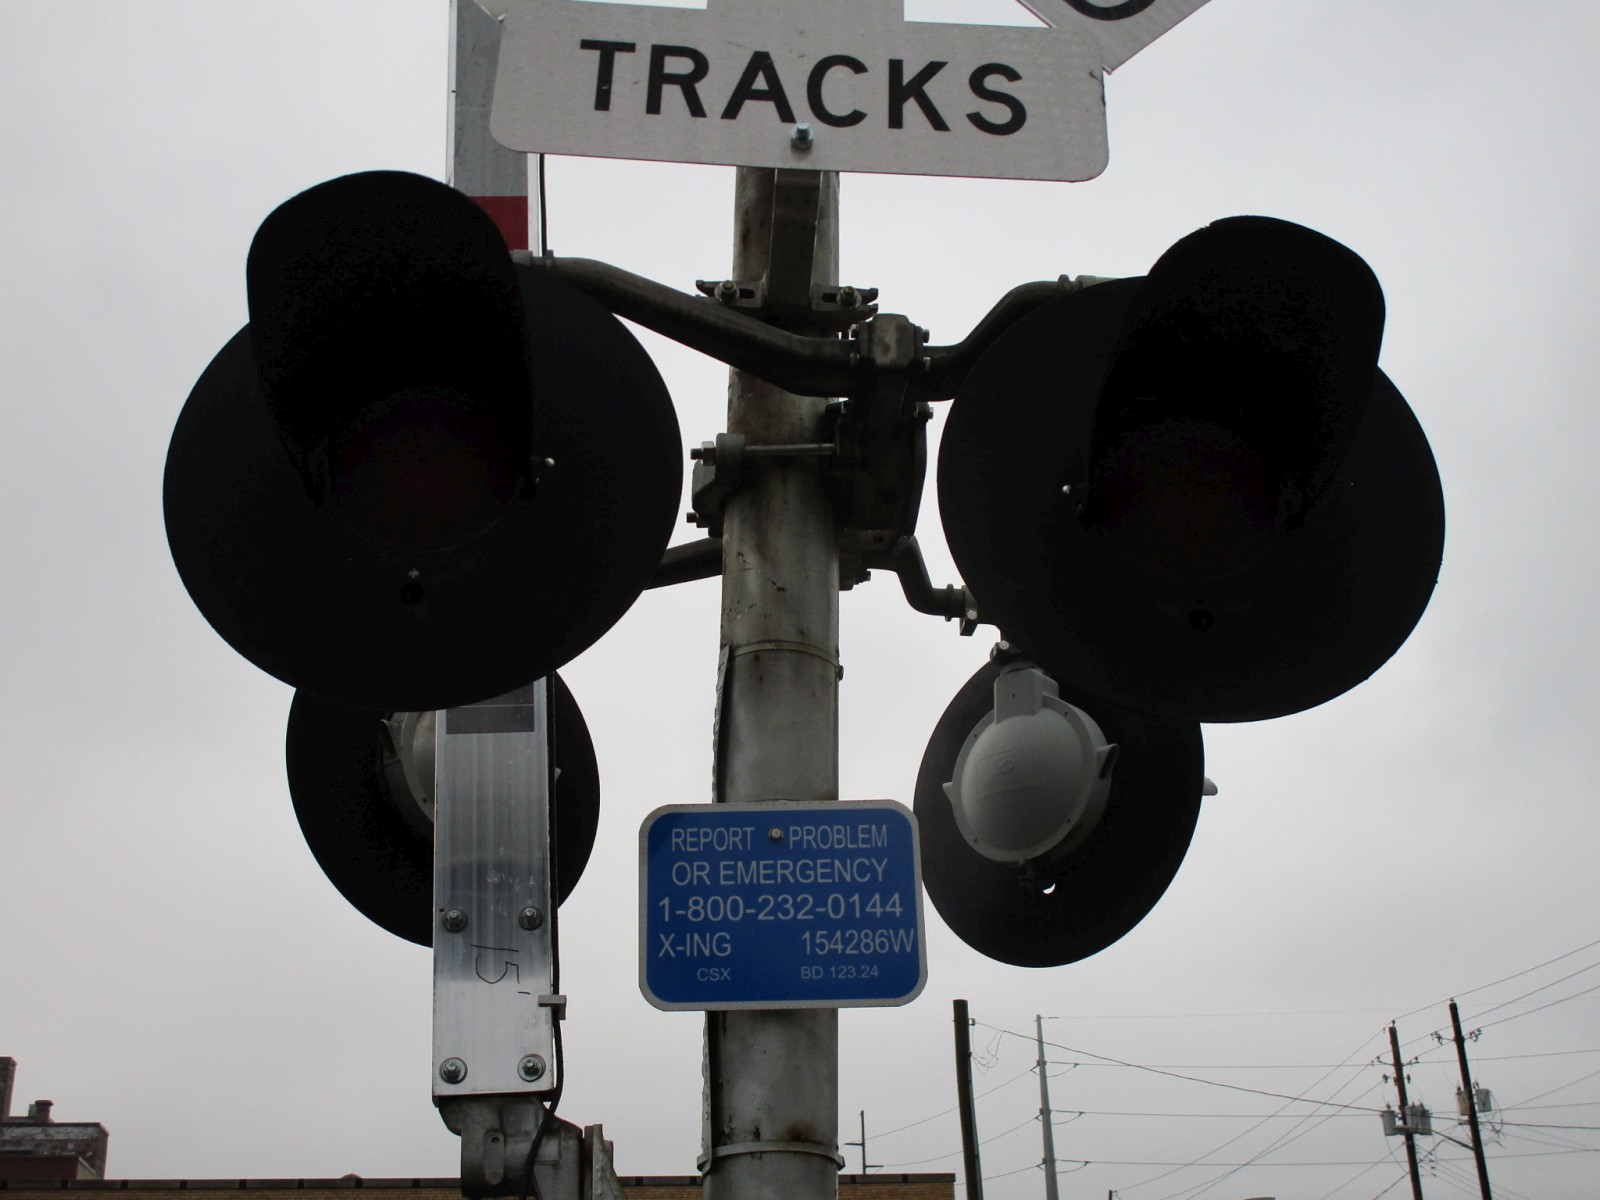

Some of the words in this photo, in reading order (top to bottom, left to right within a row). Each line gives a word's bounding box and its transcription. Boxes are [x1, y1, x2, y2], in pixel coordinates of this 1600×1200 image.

[579, 39, 1028, 135] TRACKS
[671, 827, 755, 852] REPORT
[789, 824, 888, 849] PROBLEM
[671, 861, 711, 886] OR
[719, 858, 888, 885] EMERGENCY
[658, 892, 904, 922] 1-800-232-0144
[658, 932, 732, 958] X-ING
[801, 928, 915, 955] 154286W
[697, 968, 731, 981] CSX
[800, 966, 824, 979] BD
[829, 965, 879, 979] 123.24
